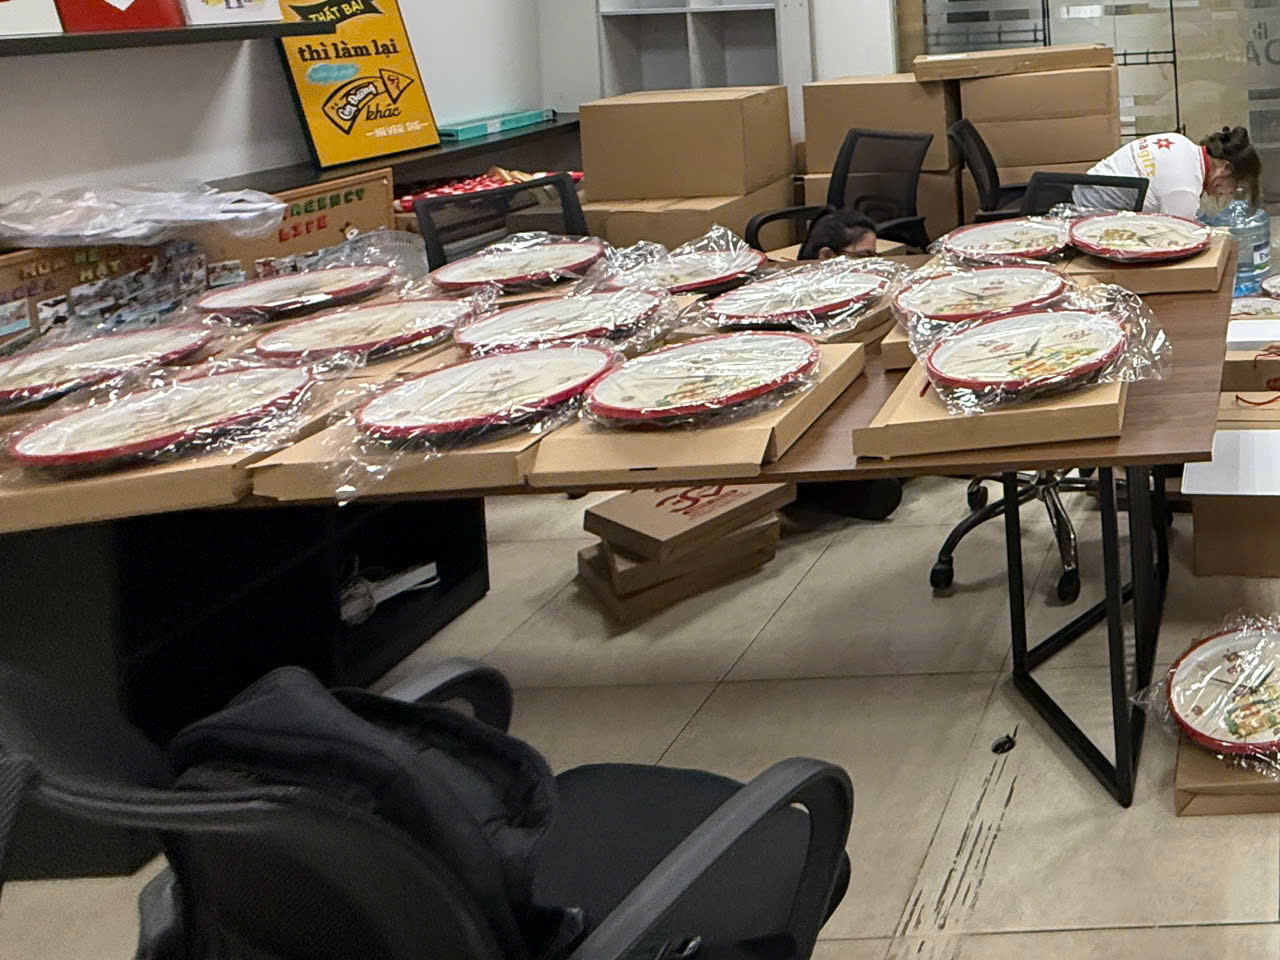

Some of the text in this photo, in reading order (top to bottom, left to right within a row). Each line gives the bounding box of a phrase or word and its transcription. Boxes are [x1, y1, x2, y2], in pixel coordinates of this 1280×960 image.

[342, 0, 365, 14] BẠI
[298, 38, 400, 62] thì làm lại
[365, 103, 401, 121] khác
